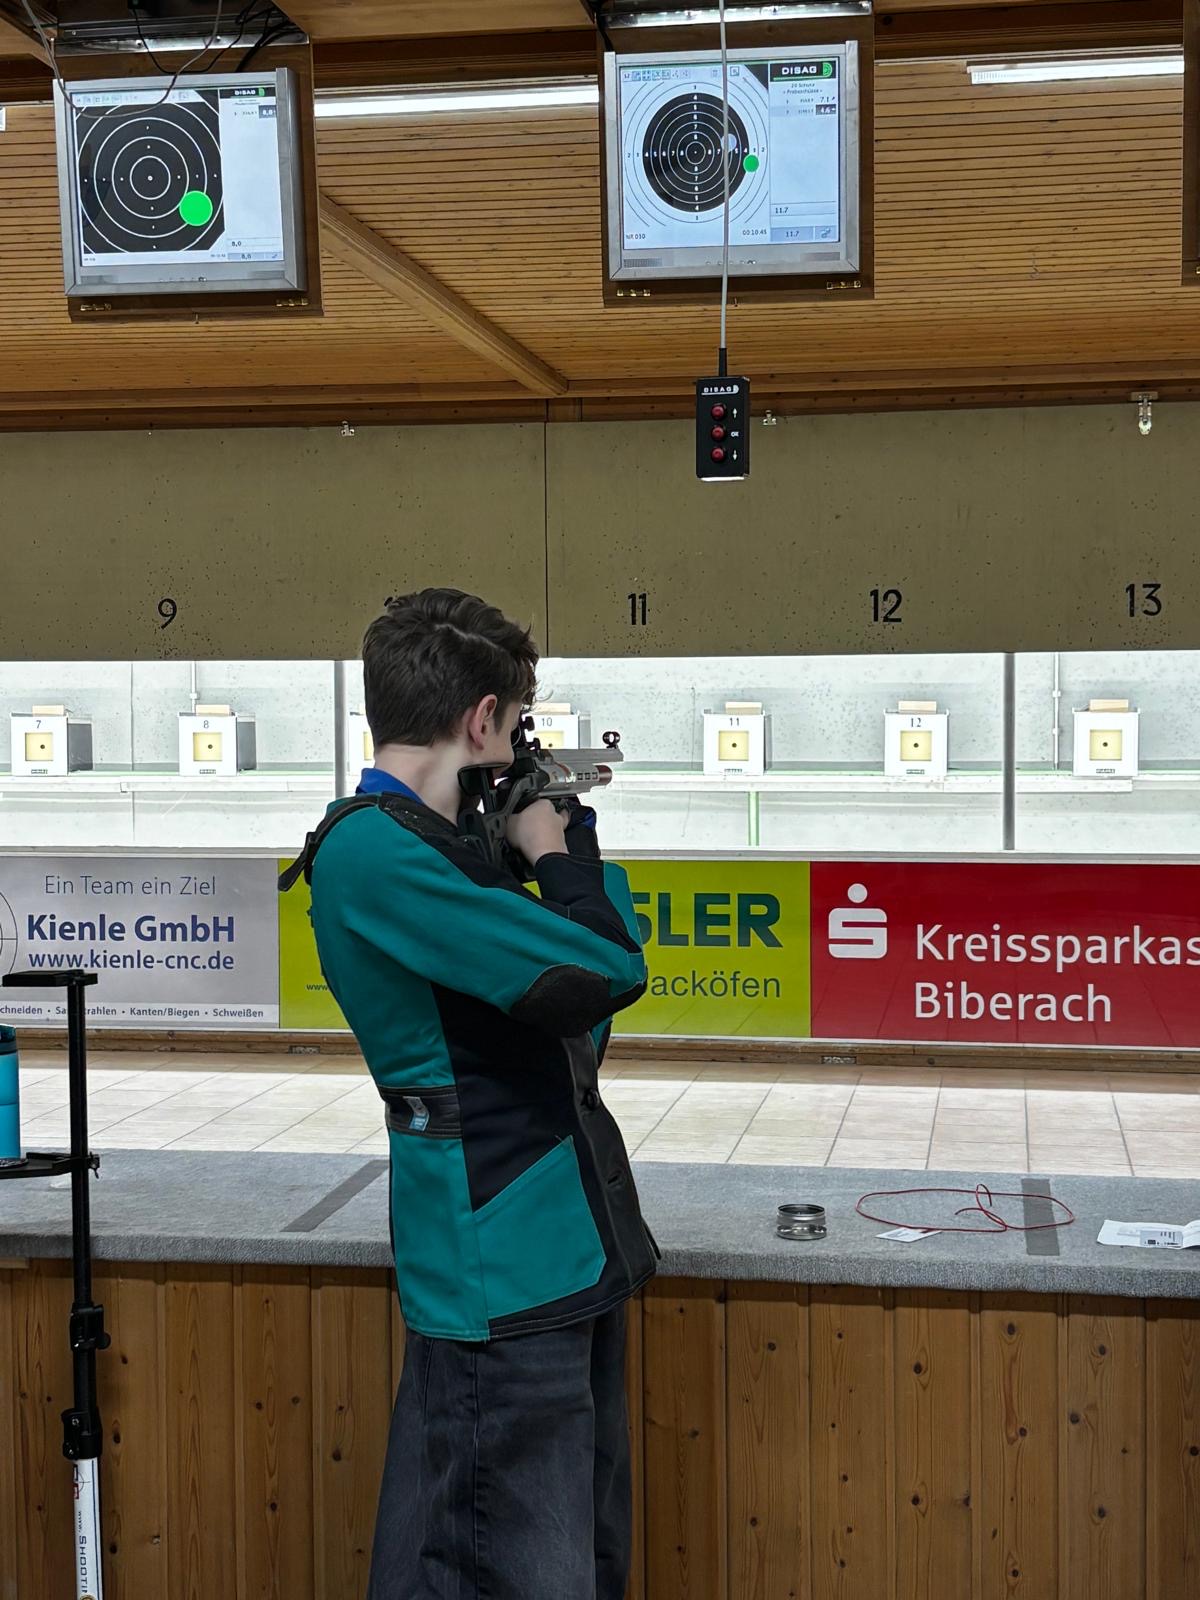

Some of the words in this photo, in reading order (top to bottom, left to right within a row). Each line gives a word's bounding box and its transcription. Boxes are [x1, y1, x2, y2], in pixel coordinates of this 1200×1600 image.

[781, 66, 817, 75] DISAG
[785, 230, 800, 238] 11.7
[627, 594, 648, 626] 11
[869, 589, 903, 623] 12
[1125, 583, 1163, 618] 13
[158, 598, 177, 630] 9
[35, 719, 42, 729] 7
[203, 719, 210, 729] 8
[541, 717, 553, 727] 10
[729, 717, 741, 727] 11
[910, 717, 922, 728] 12
[45, 875, 74, 894] Ein
[80, 875, 134, 895] Team
[141, 876, 172, 895] ein
[180, 875, 216, 896] Ziel
[27, 913, 126, 942] Kienle
[134, 914, 235, 943] GmbH
[916, 923, 1200, 973] Kreissparkas
[28, 949, 235, 970] www.kienle-cnc.de
[915, 980, 1112, 1023] Biberach
[55, 1006, 117, 1016] Sarahlen
[130, 1007, 200, 1019] Kanten/Biegen
[212, 1008, 264, 1018] Schweißen
